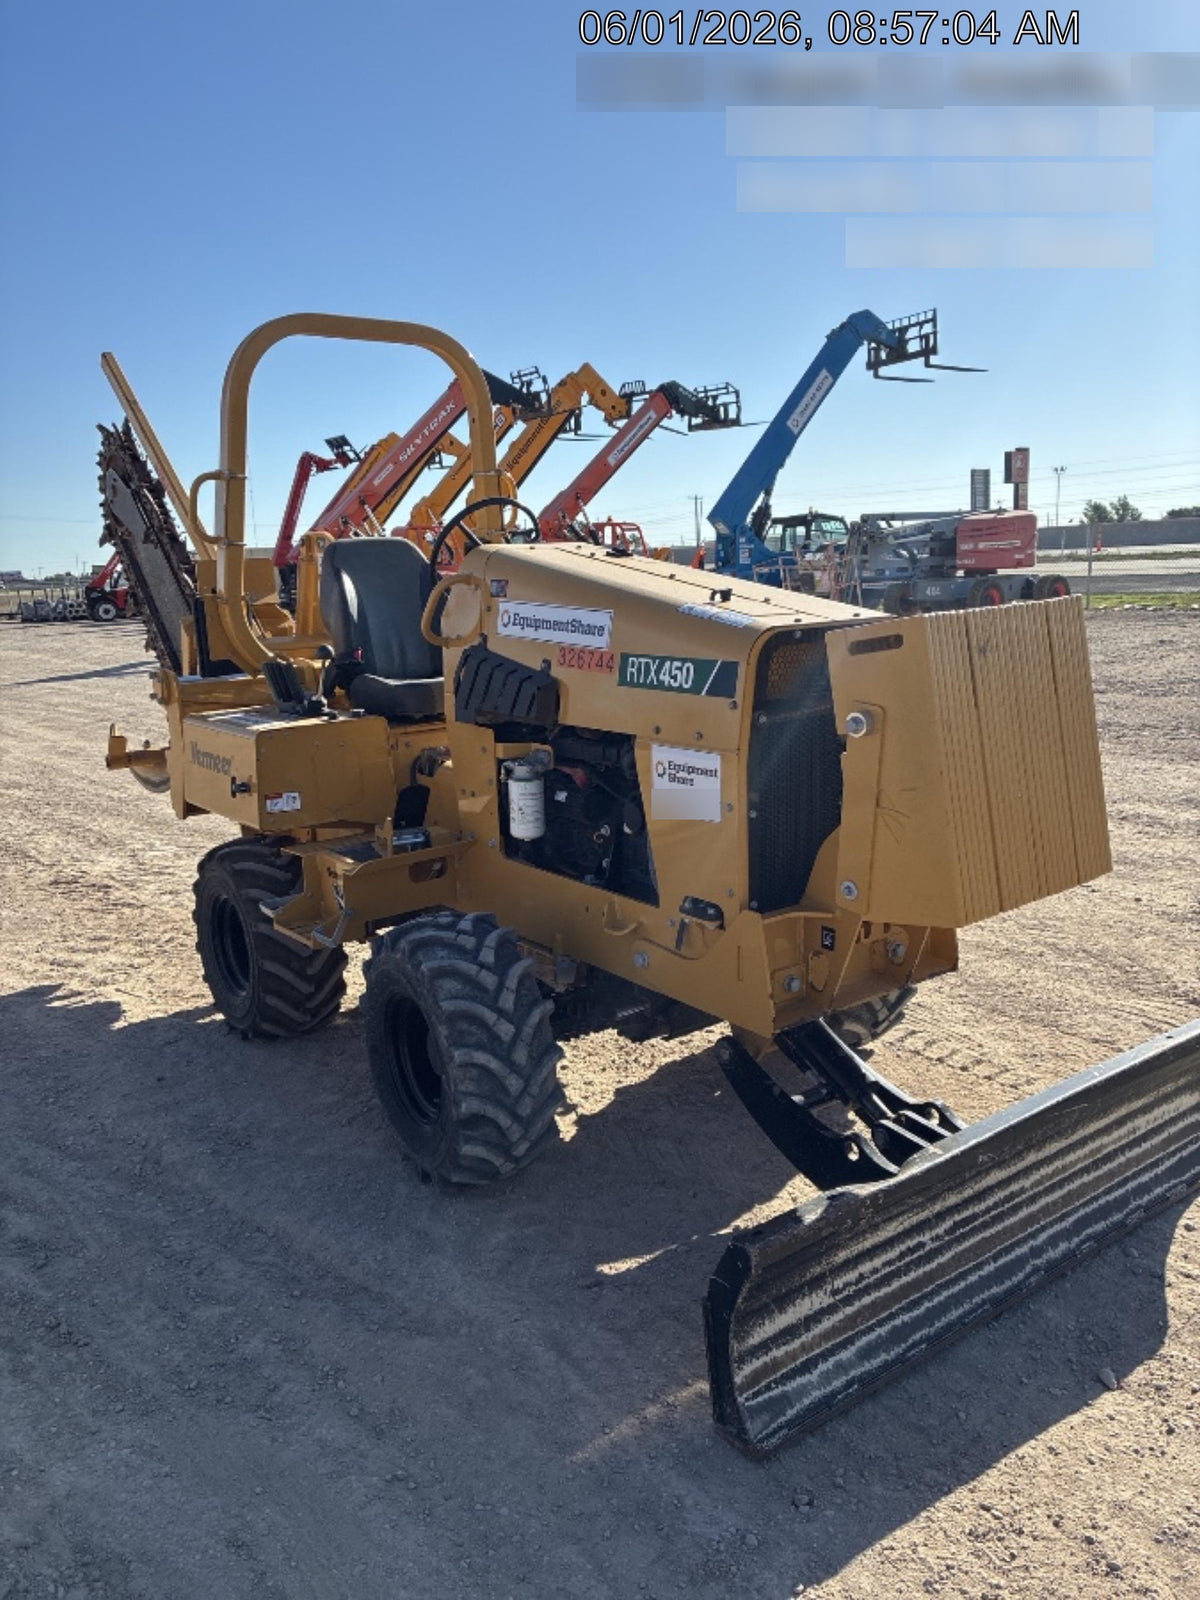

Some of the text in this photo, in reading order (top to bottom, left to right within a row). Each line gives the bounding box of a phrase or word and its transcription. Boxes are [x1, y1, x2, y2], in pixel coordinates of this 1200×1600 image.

[511, 612, 606, 637] EquipmentShare
[558, 646, 615, 673] 326744
[190, 741, 232, 775] Vermeer
[667, 760, 718, 778] Equipment
[667, 771, 695, 787] Share
